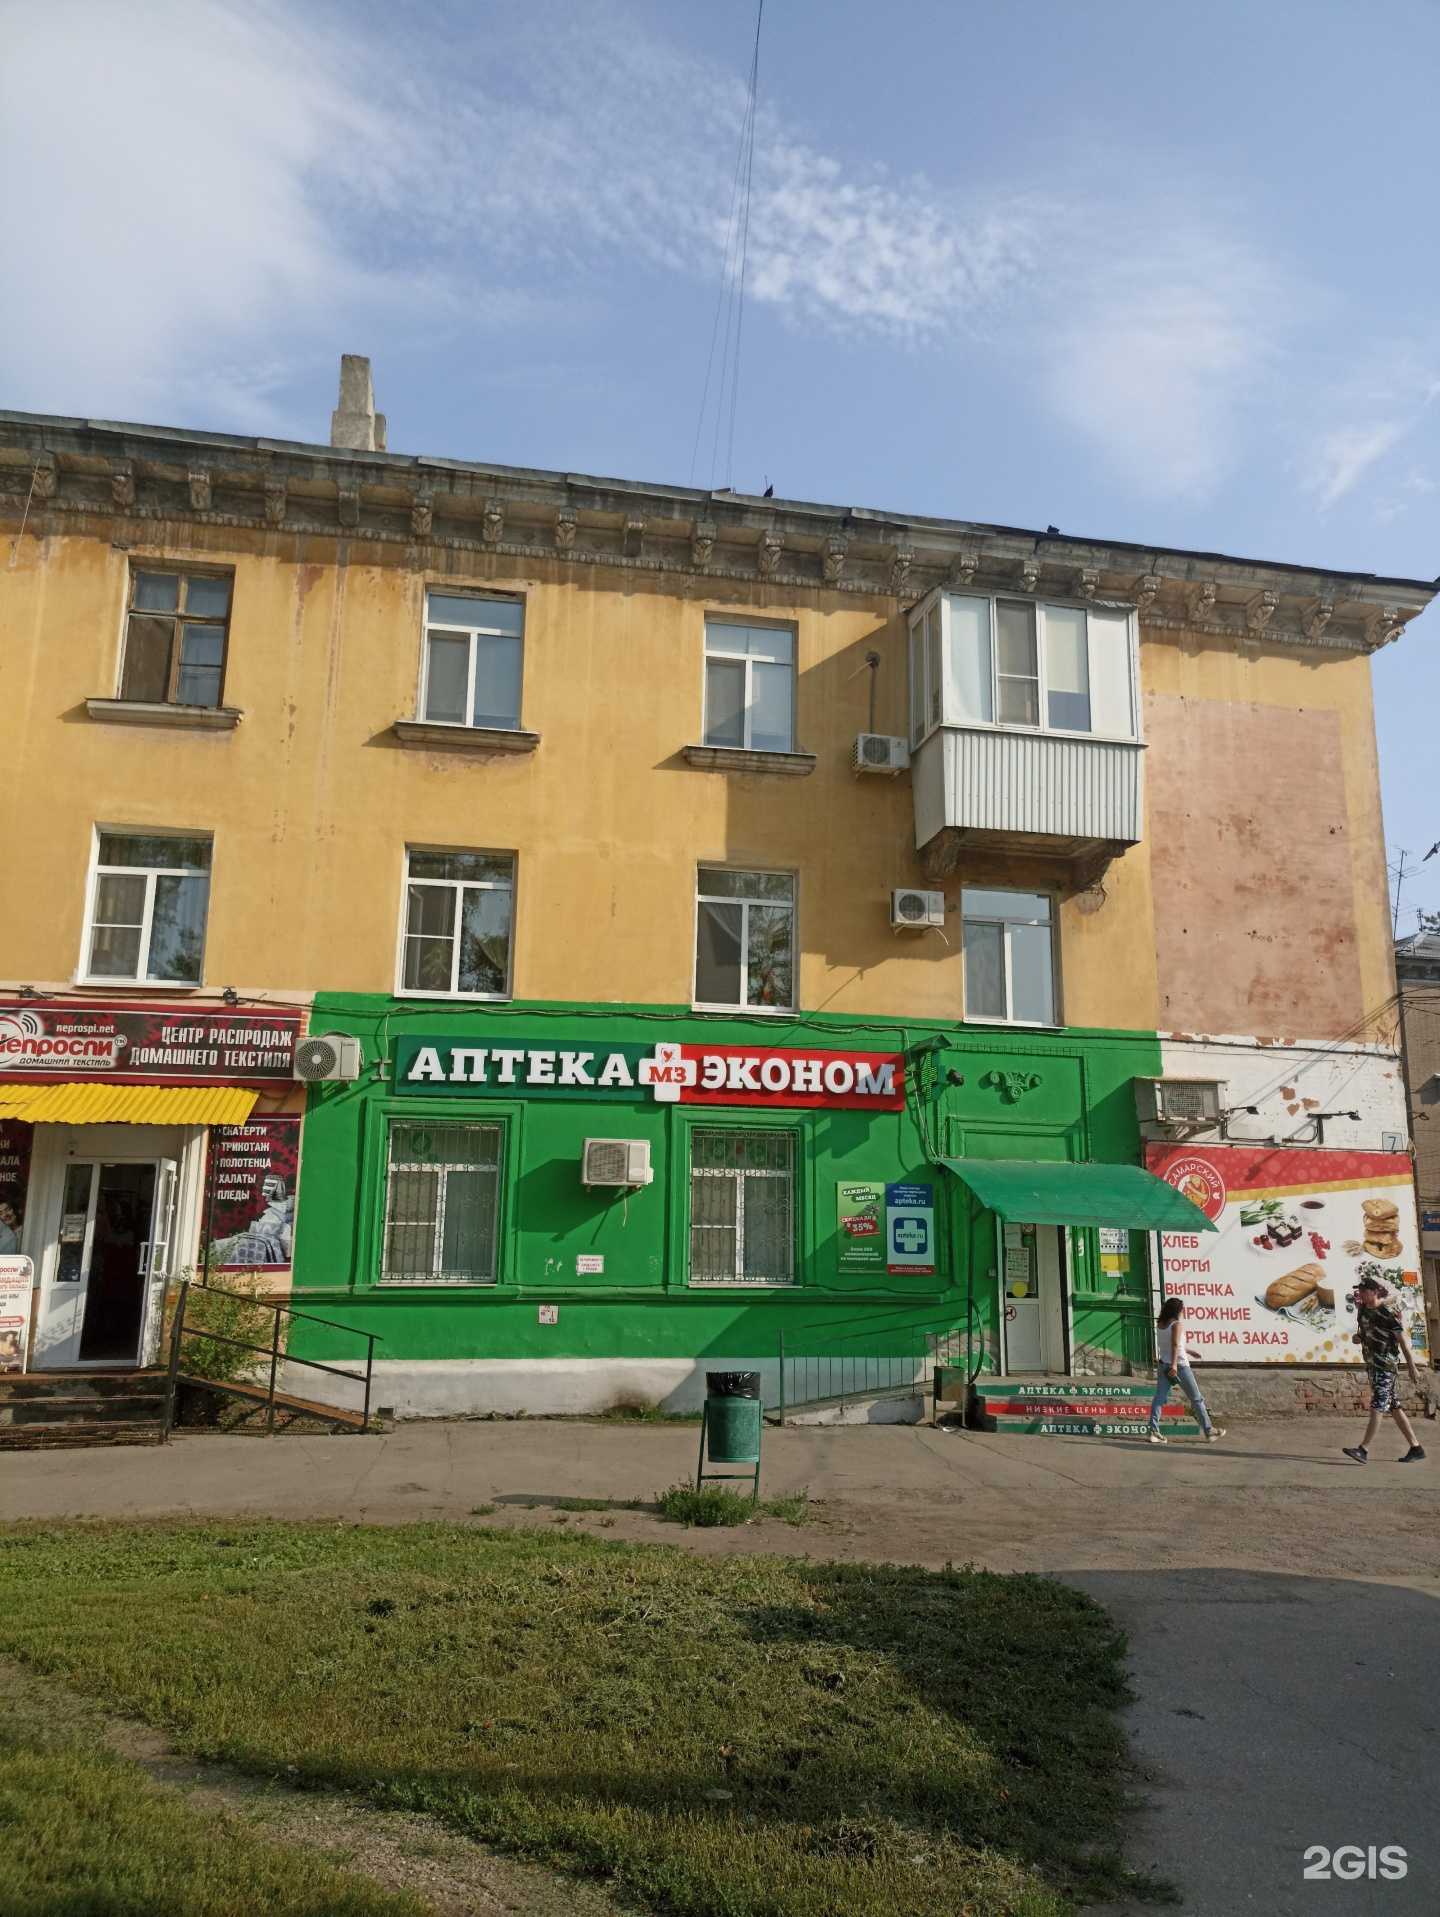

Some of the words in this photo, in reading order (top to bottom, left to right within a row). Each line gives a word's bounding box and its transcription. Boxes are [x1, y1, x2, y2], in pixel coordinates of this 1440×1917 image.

[55, 1023, 114, 1034] neprospi.net
[160, 1026, 204, 1045] ЦЕНТР
[208, 1028, 293, 1047] РАСПРОДАЖ
[129, 1047, 218, 1067] ДОМАШНЕГО
[223, 1050, 291, 1068] ТЕКСТИЛЯ
[408, 1047, 635, 1087] АПТЕКА
[700, 1055, 897, 1096] ЭКОНОМ
[222, 1126, 267, 1136] СКАТЕРТИ
[221, 1142, 270, 1152] ТРИКОТАЖ
[219, 1158, 272, 1169] ПОЛОТЕНЦА
[218, 1173, 257, 1184] ХАЛАТЫ
[1168, 1163, 1220, 1188] САМАРСКИЙ
[217, 1190, 250, 1201] ПЛЕДЫ
[1162, 1235, 1199, 1248] ХЛЕБ
[1162, 1259, 1211, 1272] ТОРТЫ
[1165, 1282, 1234, 1296] ВЫПЕЧКА
[1182, 1306, 1251, 1321] РОЖНЫЕ
[1185, 1331, 1215, 1344] РТЫ
[1218, 1332, 1239, 1345] НА
[1242, 1332, 1289, 1346] ЗАКАЗ
[1018, 1387, 1065, 1395] АПТЕКА
[1081, 1387, 1132, 1396] ЭКОНОМ
[1025, 1405, 1072, 1414] НИЗКИЕ
[1075, 1406, 1107, 1415] ЦЕНЫ
[1112, 1406, 1147, 1416] ЗДЕСЬ
[1040, 1424, 1089, 1433] АПТЕКА
[1106, 1425, 1151, 1434] ЭКОНО
